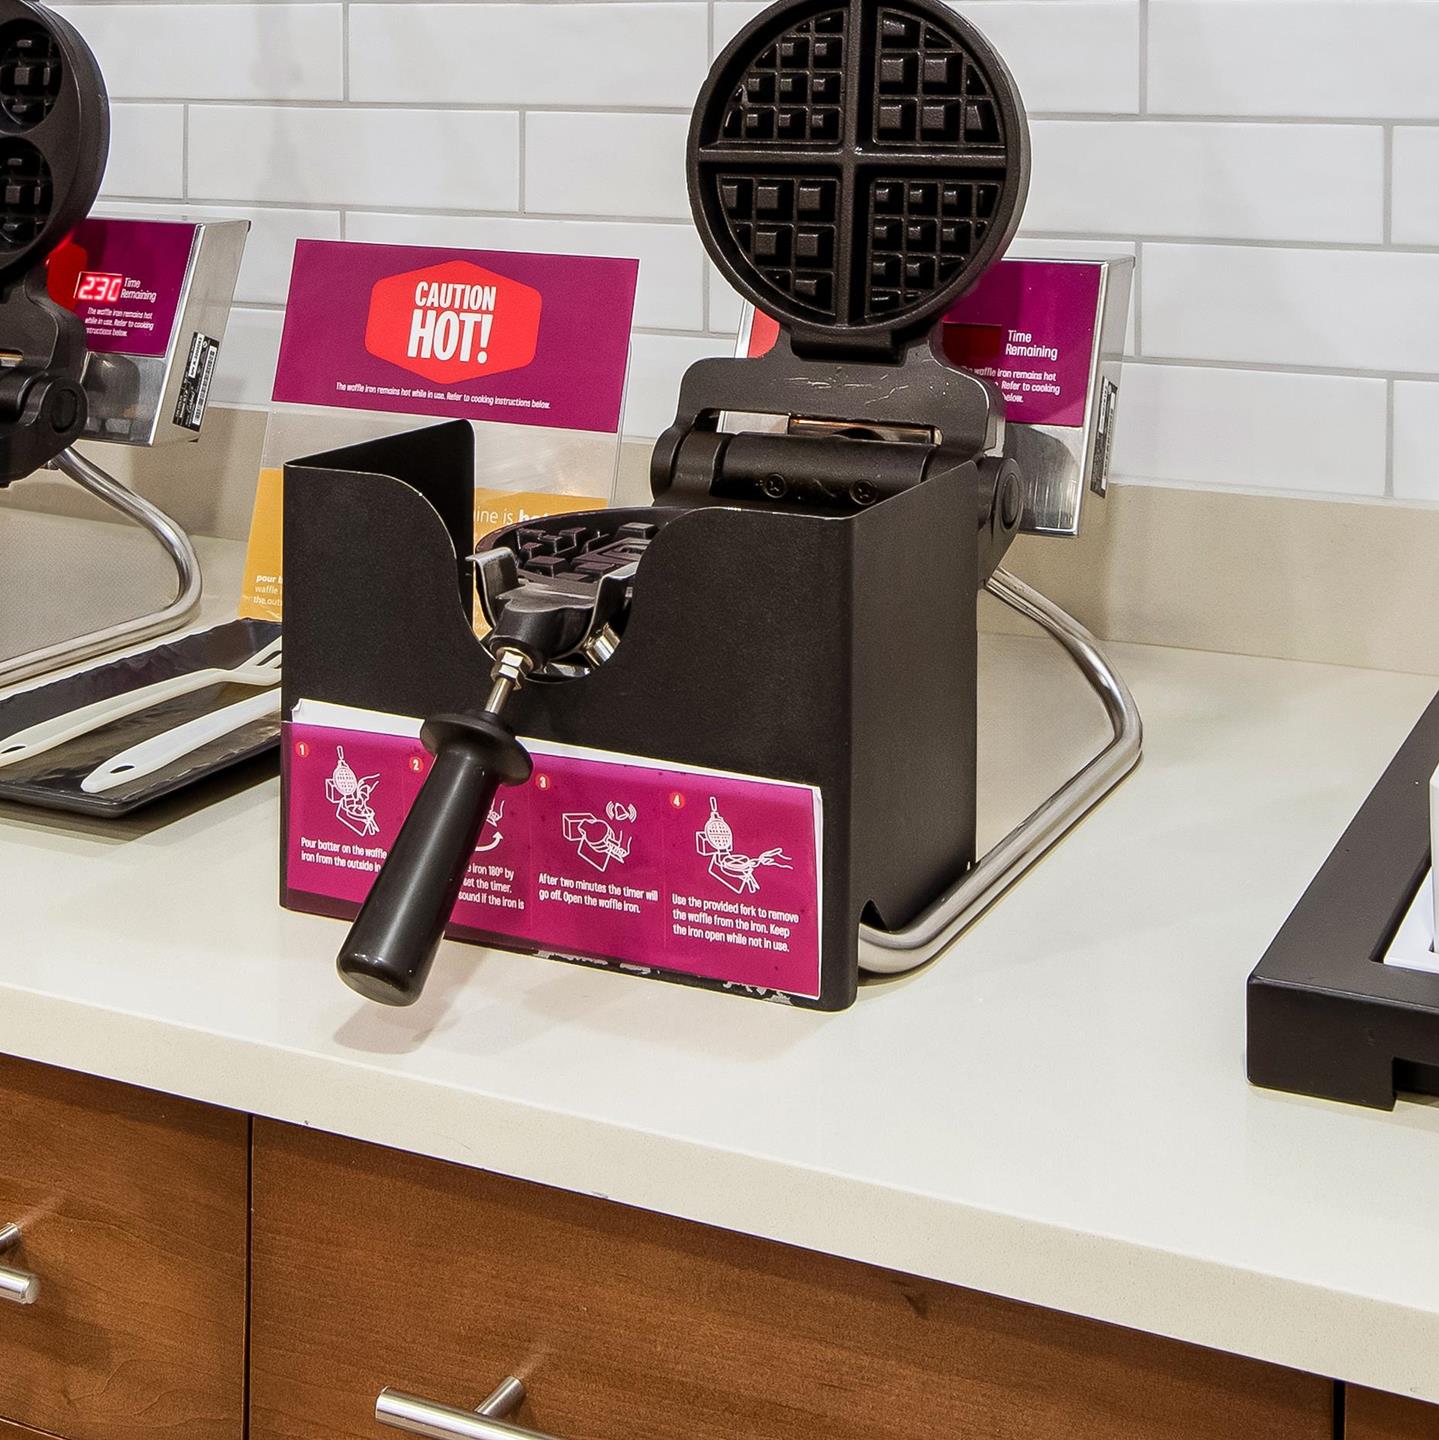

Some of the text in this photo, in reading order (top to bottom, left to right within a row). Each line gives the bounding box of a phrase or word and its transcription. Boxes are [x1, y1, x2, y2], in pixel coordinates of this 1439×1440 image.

[124, 277, 141, 288] Time
[120, 289, 157, 303] Remaining
[415, 281, 496, 311] CAUTION
[88, 307, 96, 315] The
[134, 322, 154, 330] cooking
[407, 309, 493, 364] HOT!
[1008, 329, 1032, 343] Time
[1006, 343, 1058, 361] Remaining
[974, 367, 996, 377] waffle
[997, 368, 1012, 378] iron
[1013, 370, 1042, 380] remains
[1043, 372, 1056, 381] hot
[336, 382, 551, 409] The waffle iron remains hot while in use. Refer to cooking instructions below.
[1001, 380, 1060, 396] Refer to cooking
[503, 508, 513, 524] is
[255, 585, 278, 594] waffle
[300, 744, 304, 755] 1
[413, 760, 419, 770] 2
[540, 776, 546, 788] 3
[673, 794, 680, 806] 4
[301, 837, 388, 859] Pour batter on the waffle
[301, 851, 315, 862] iron
[316, 853, 333, 865] from
[334, 856, 346, 866] the
[347, 858, 373, 871] outside
[473, 863, 487, 875] iron
[505, 868, 514, 881] by
[476, 879, 489, 889] the
[490, 880, 512, 893] timer.
[539, 873, 658, 900] After two minutes the timer will
[458, 891, 524, 909] sound if the iron is
[539, 890, 640, 913] go off. Open the waffle iron.
[671, 893, 799, 923] Use the provided fork to remove
[672, 909, 790, 939] the waffle from the iron. Keep
[673, 924, 790, 953] the iron open while not in use.
